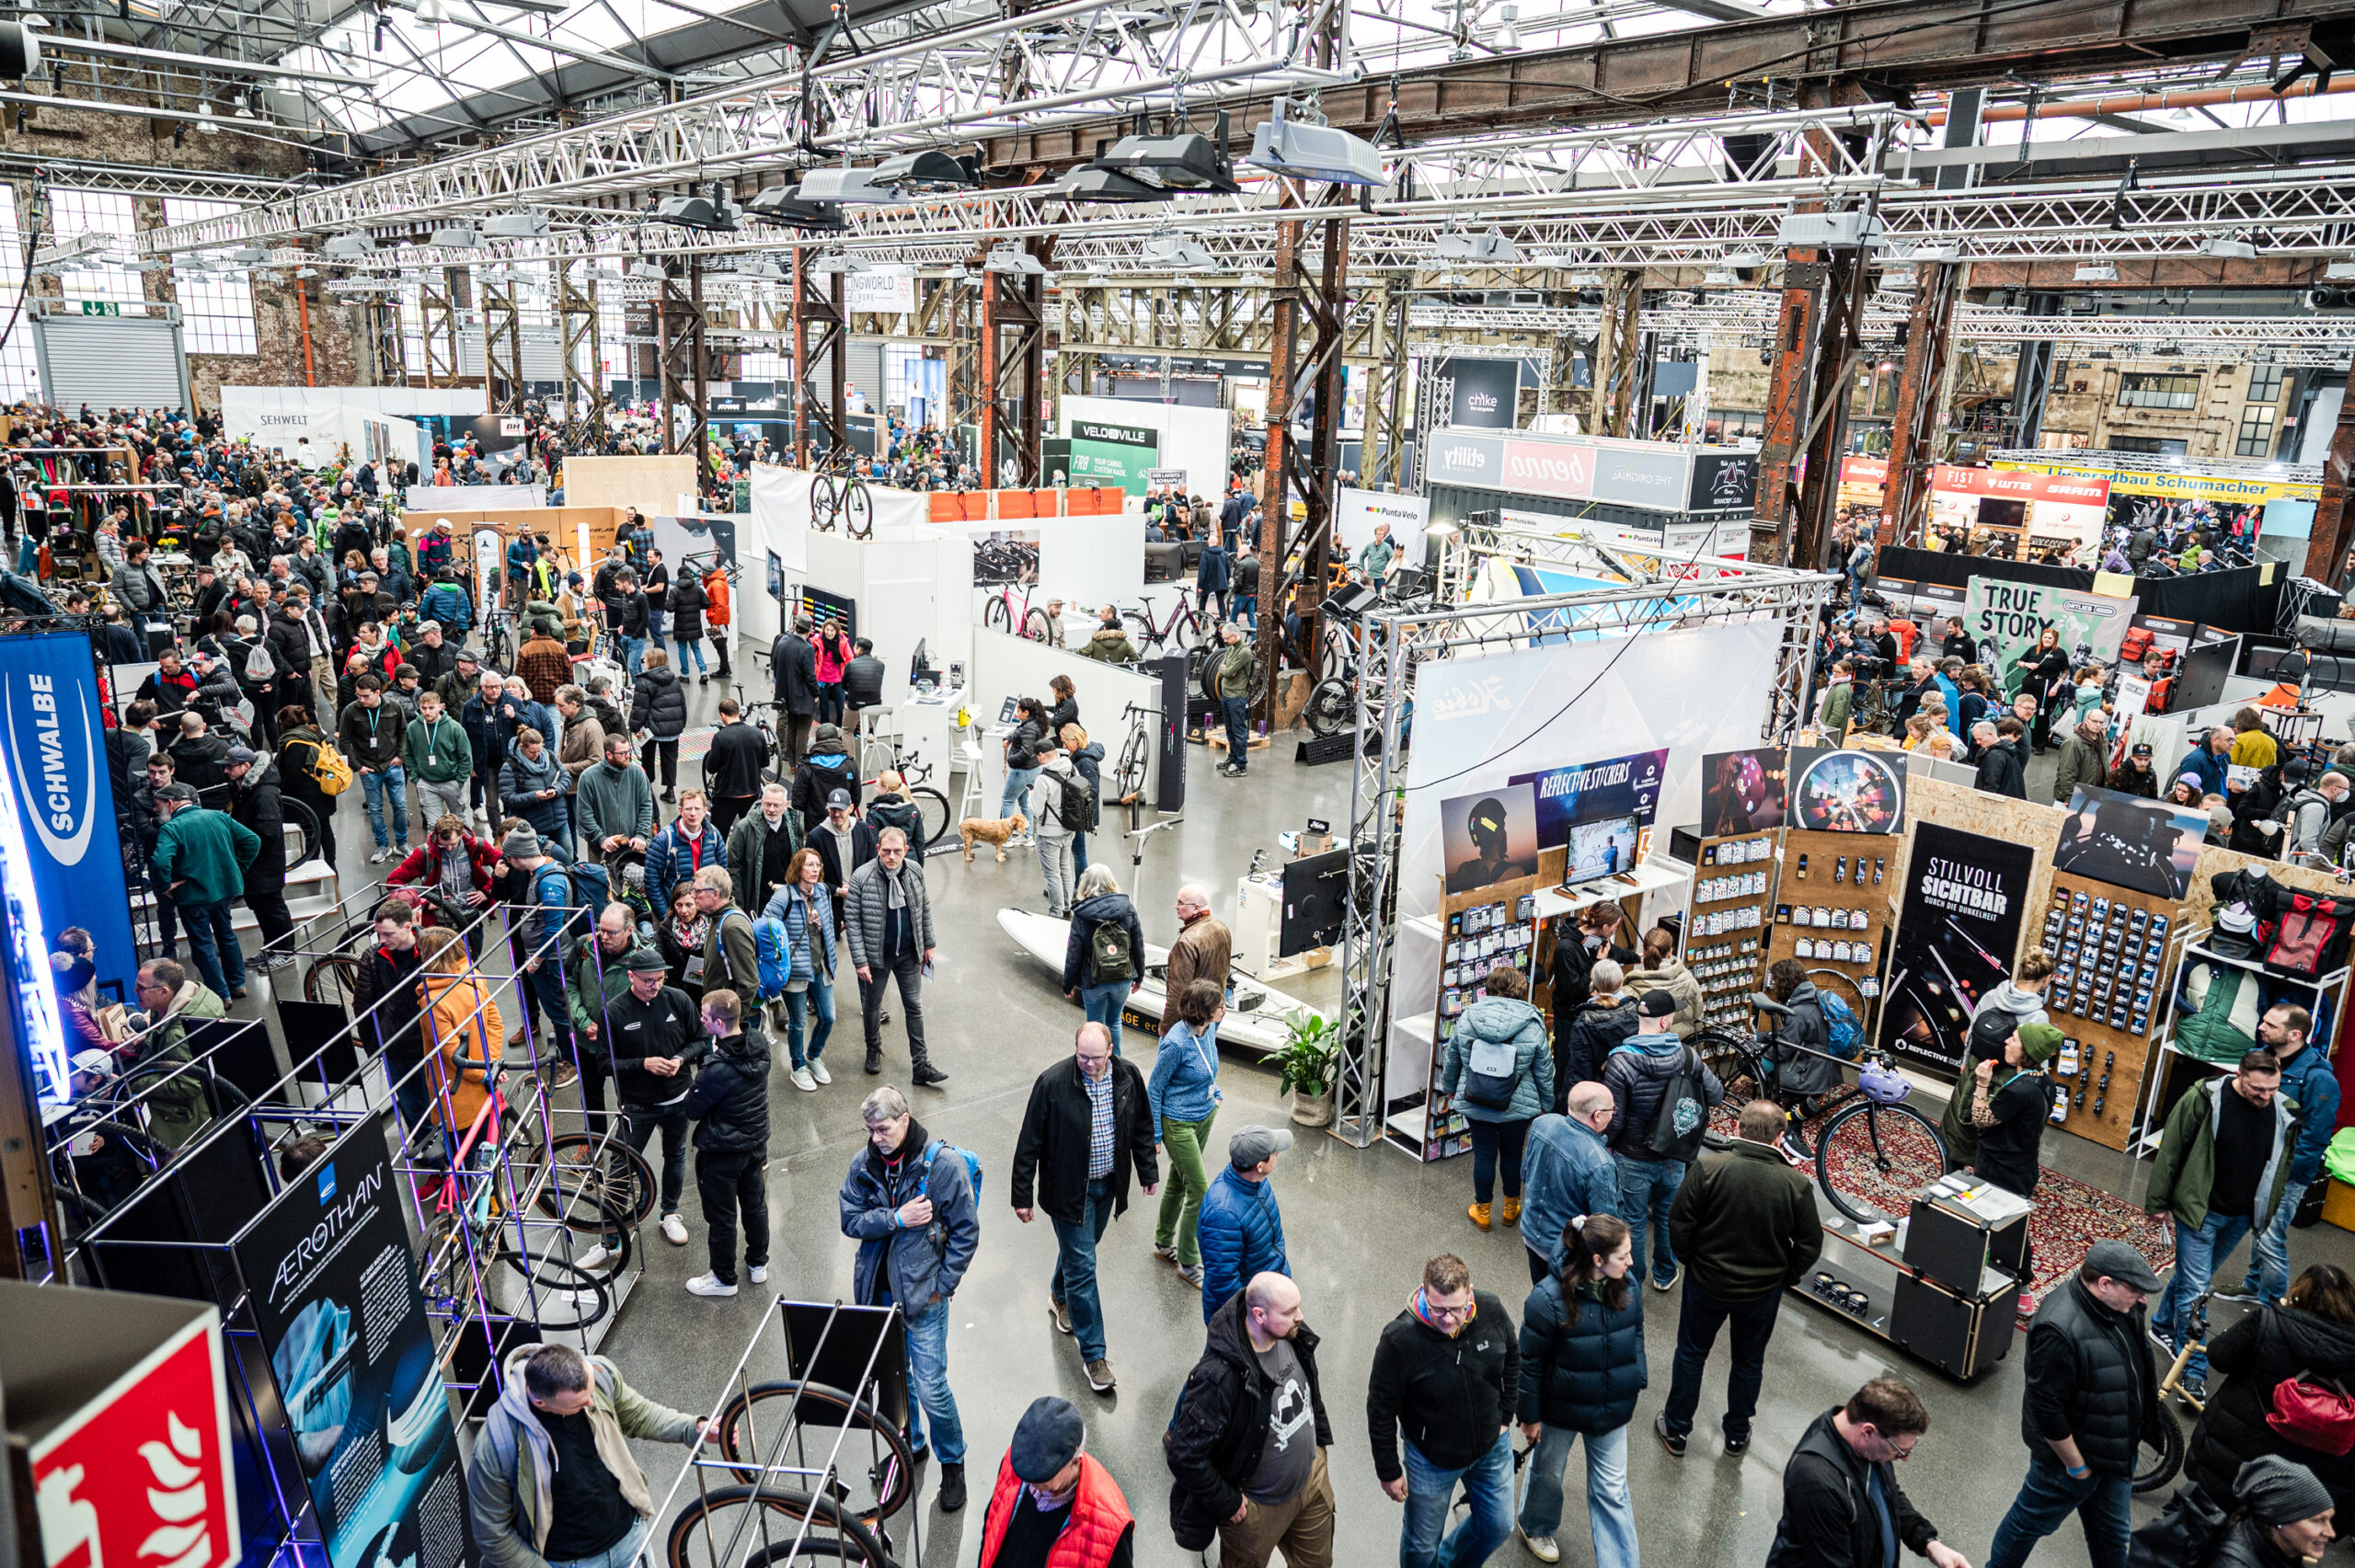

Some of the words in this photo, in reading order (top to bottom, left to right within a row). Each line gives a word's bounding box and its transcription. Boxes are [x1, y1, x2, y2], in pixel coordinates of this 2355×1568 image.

[1468, 392, 1498, 408] chike
[260, 415, 308, 427] SEHWELT
[506, 422, 521, 430] BH
[1094, 457, 1107, 466] YOUR
[1094, 465, 1113, 475] CUSTOM
[1847, 464, 1886, 479] Sunday
[1947, 470, 1975, 485] FIST
[2048, 467, 2149, 486] Ligeradbau
[2155, 475, 2269, 496] Schumacher
[2046, 485, 2103, 498] SRAM
[1984, 585, 2041, 613] TRUE
[1980, 610, 2055, 639] STORY
[29, 673, 74, 832] SCHWALBE
[1928, 857, 2003, 893] STILVOLL
[1921, 875, 2008, 915] SICHTBAR
[1924, 896, 1945, 910] DURCH
[1947, 901, 1958, 911] DIE
[1959, 904, 1997, 922] DUNKELHEIT
[1908, 1044, 1948, 1063] REFLECTIVE
